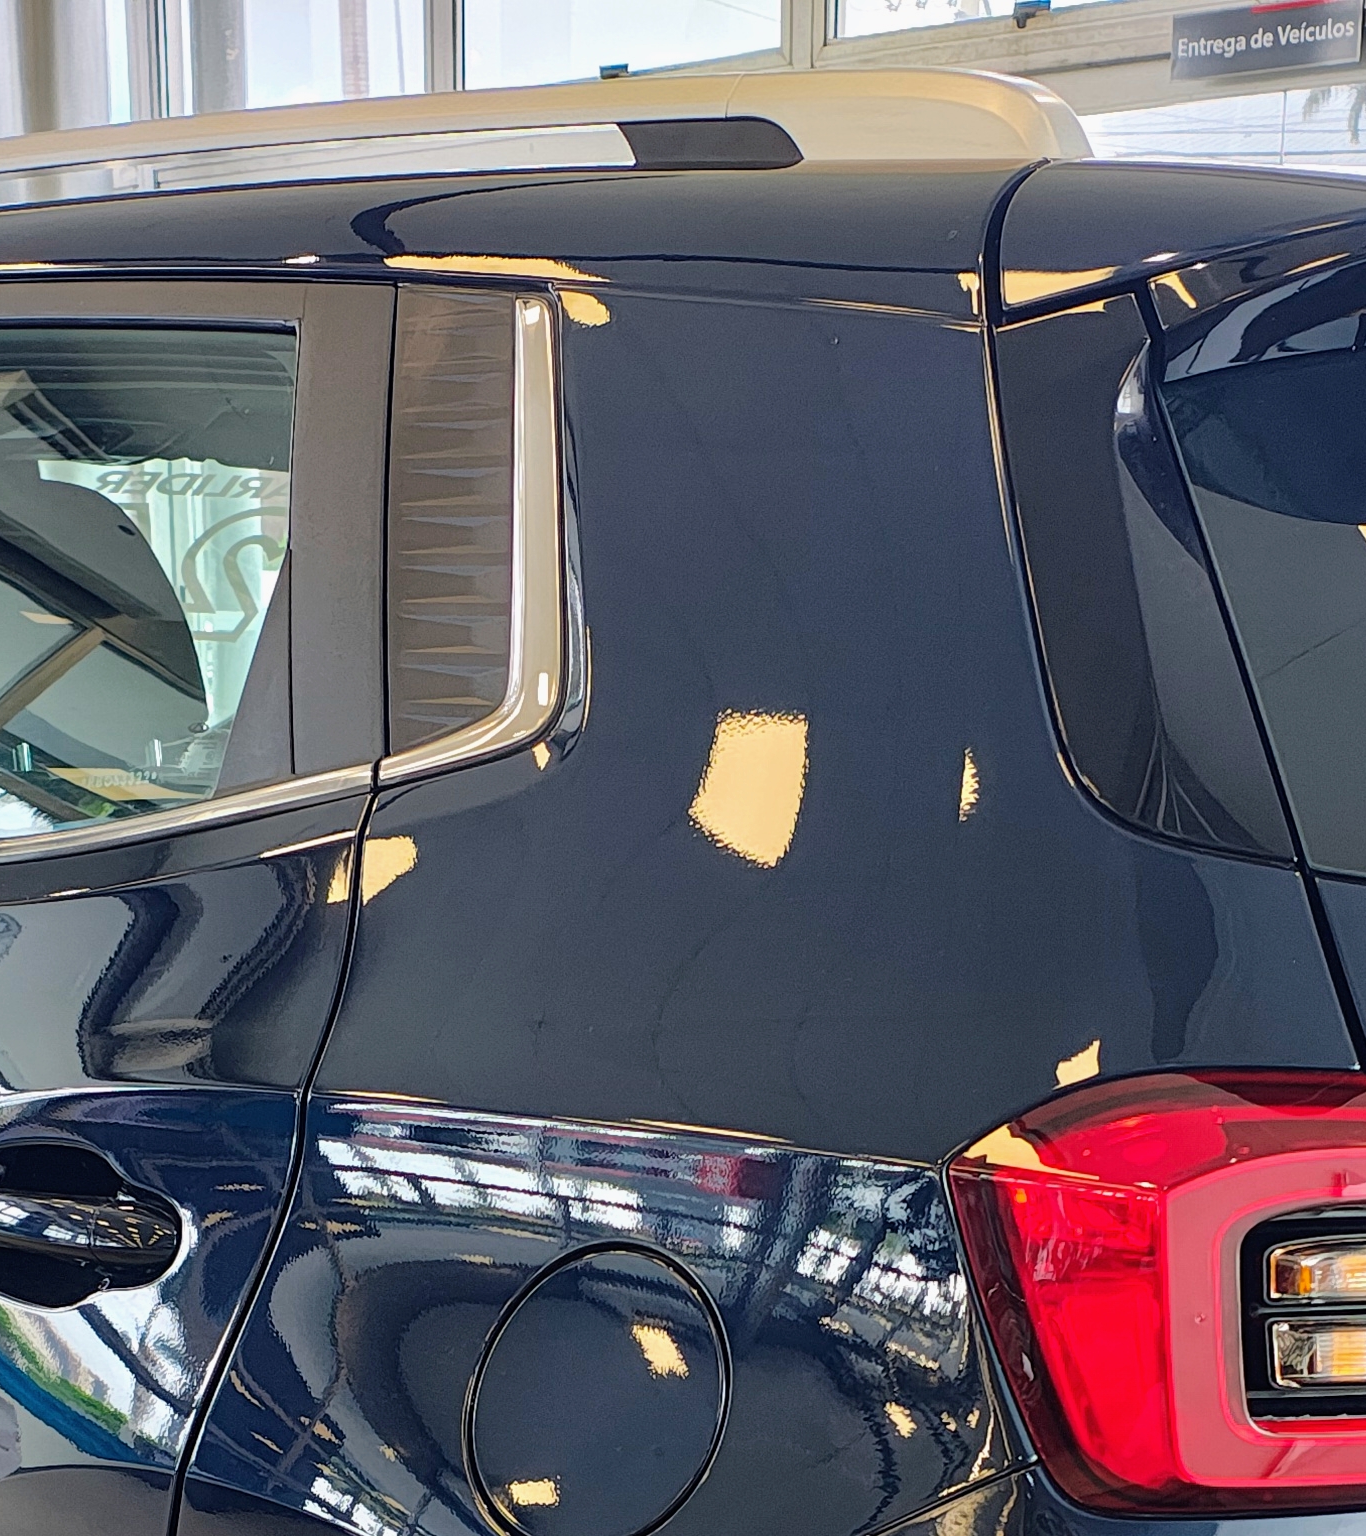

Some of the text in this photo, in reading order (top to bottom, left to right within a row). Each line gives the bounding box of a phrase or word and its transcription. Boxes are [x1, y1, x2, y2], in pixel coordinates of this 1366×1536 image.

[1178, 19, 1355, 58] Entrega de Veículos
